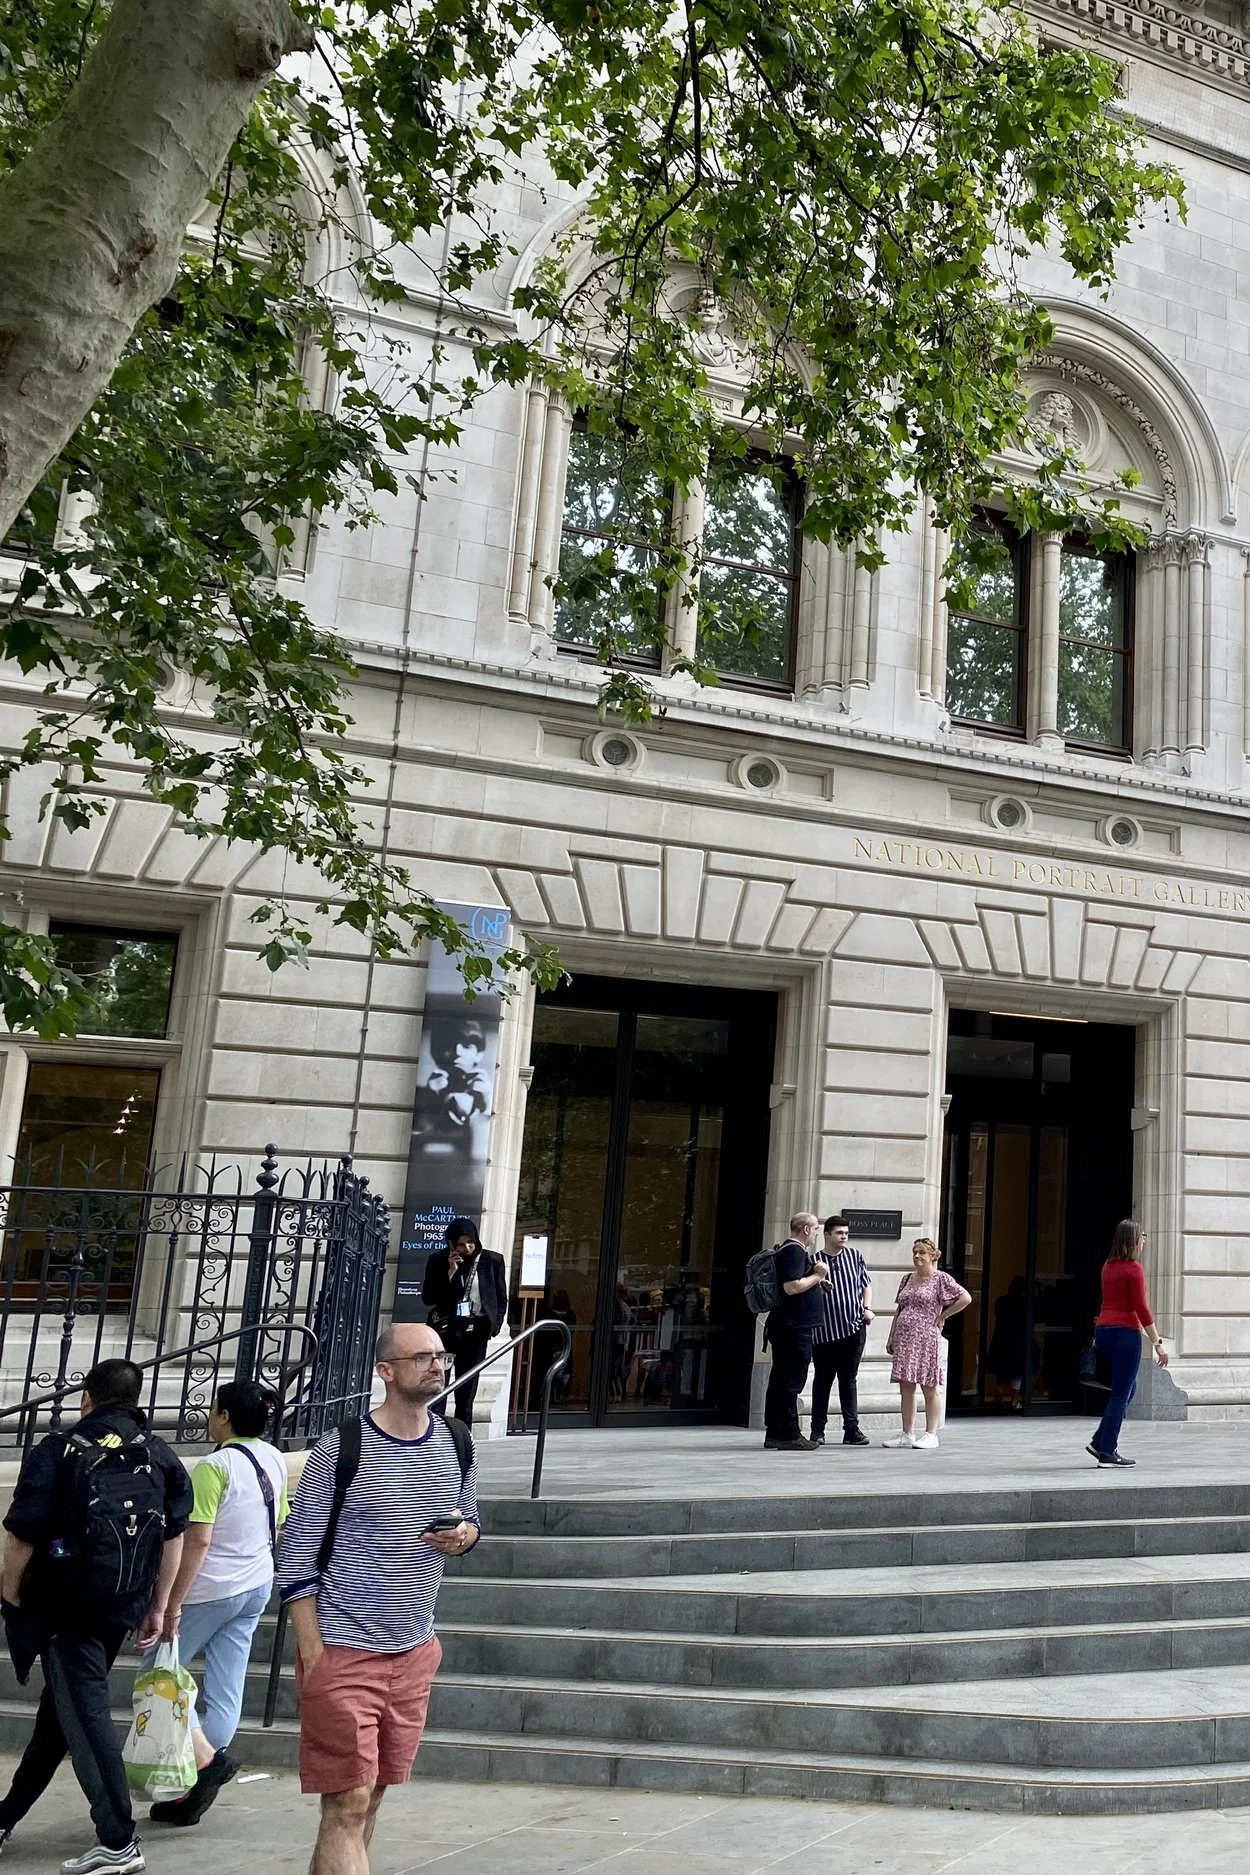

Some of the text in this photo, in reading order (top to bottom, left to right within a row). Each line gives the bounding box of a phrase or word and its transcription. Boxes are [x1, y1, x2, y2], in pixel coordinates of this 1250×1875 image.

[853, 837, 1001, 877] NATIONAL
[1012, 860, 1144, 898] PORTRAIT
[432, 1205, 455, 1214] PAUL
[414, 1213, 471, 1222] McCART
[414, 1223, 450, 1232] Photogr
[423, 1232, 445, 1240] 1963
[402, 1241, 422, 1250] Eyes
[424, 1241, 433, 1249] of
